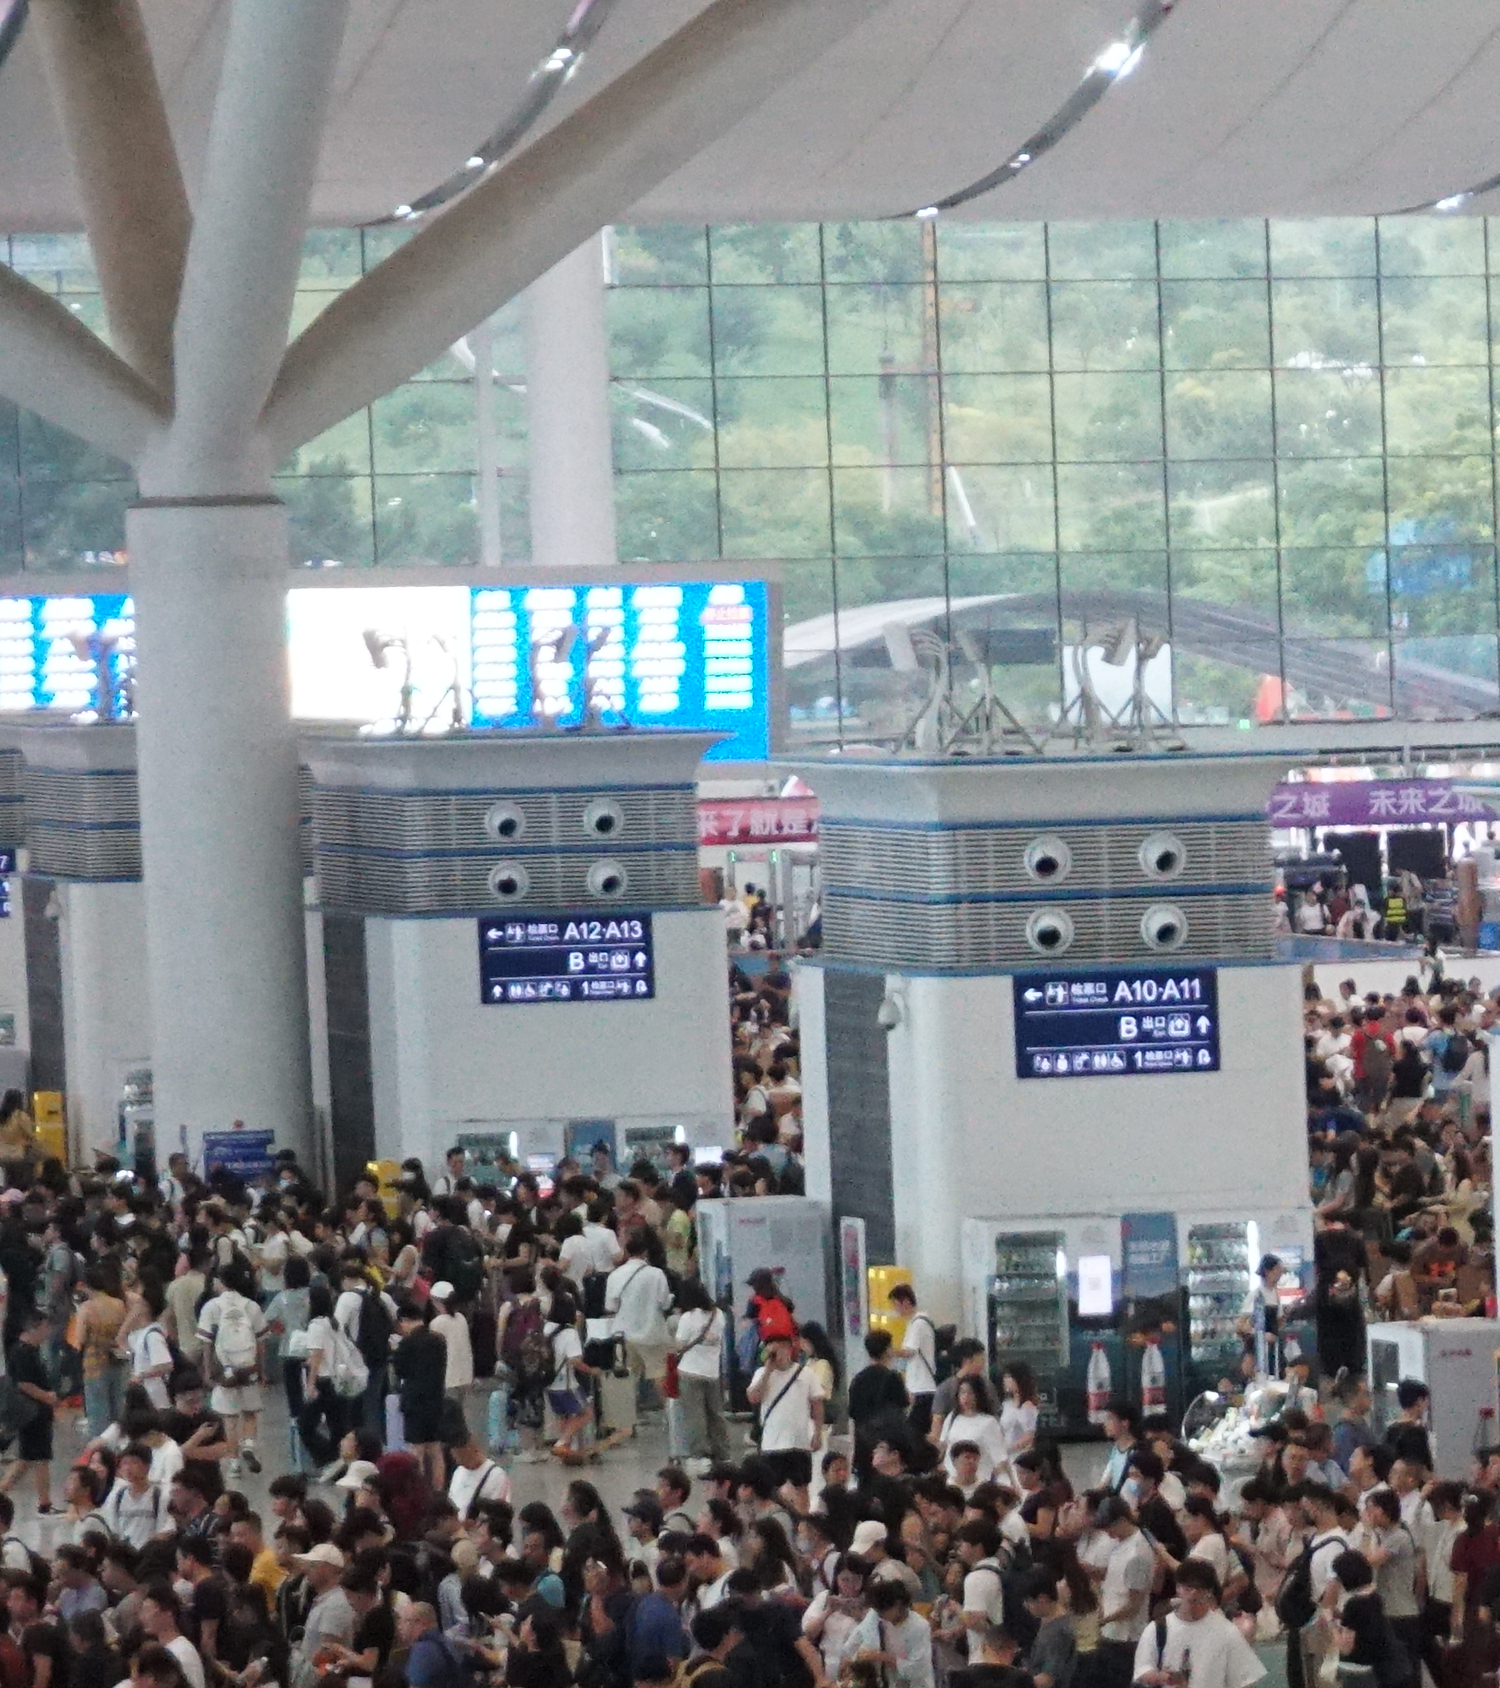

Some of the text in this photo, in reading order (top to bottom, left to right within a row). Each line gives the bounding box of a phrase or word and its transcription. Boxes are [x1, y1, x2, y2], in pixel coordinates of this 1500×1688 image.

[1266, 787, 1485, 819] 之城 未来之城
[564, 920, 643, 940] A12·A13
[569, 952, 609, 971] B 出口
[582, 981, 589, 995] 1
[1113, 978, 1201, 1002] A10·A11
[1119, 1016, 1166, 1040] B 出口
[1134, 1051, 1142, 1068] 1
